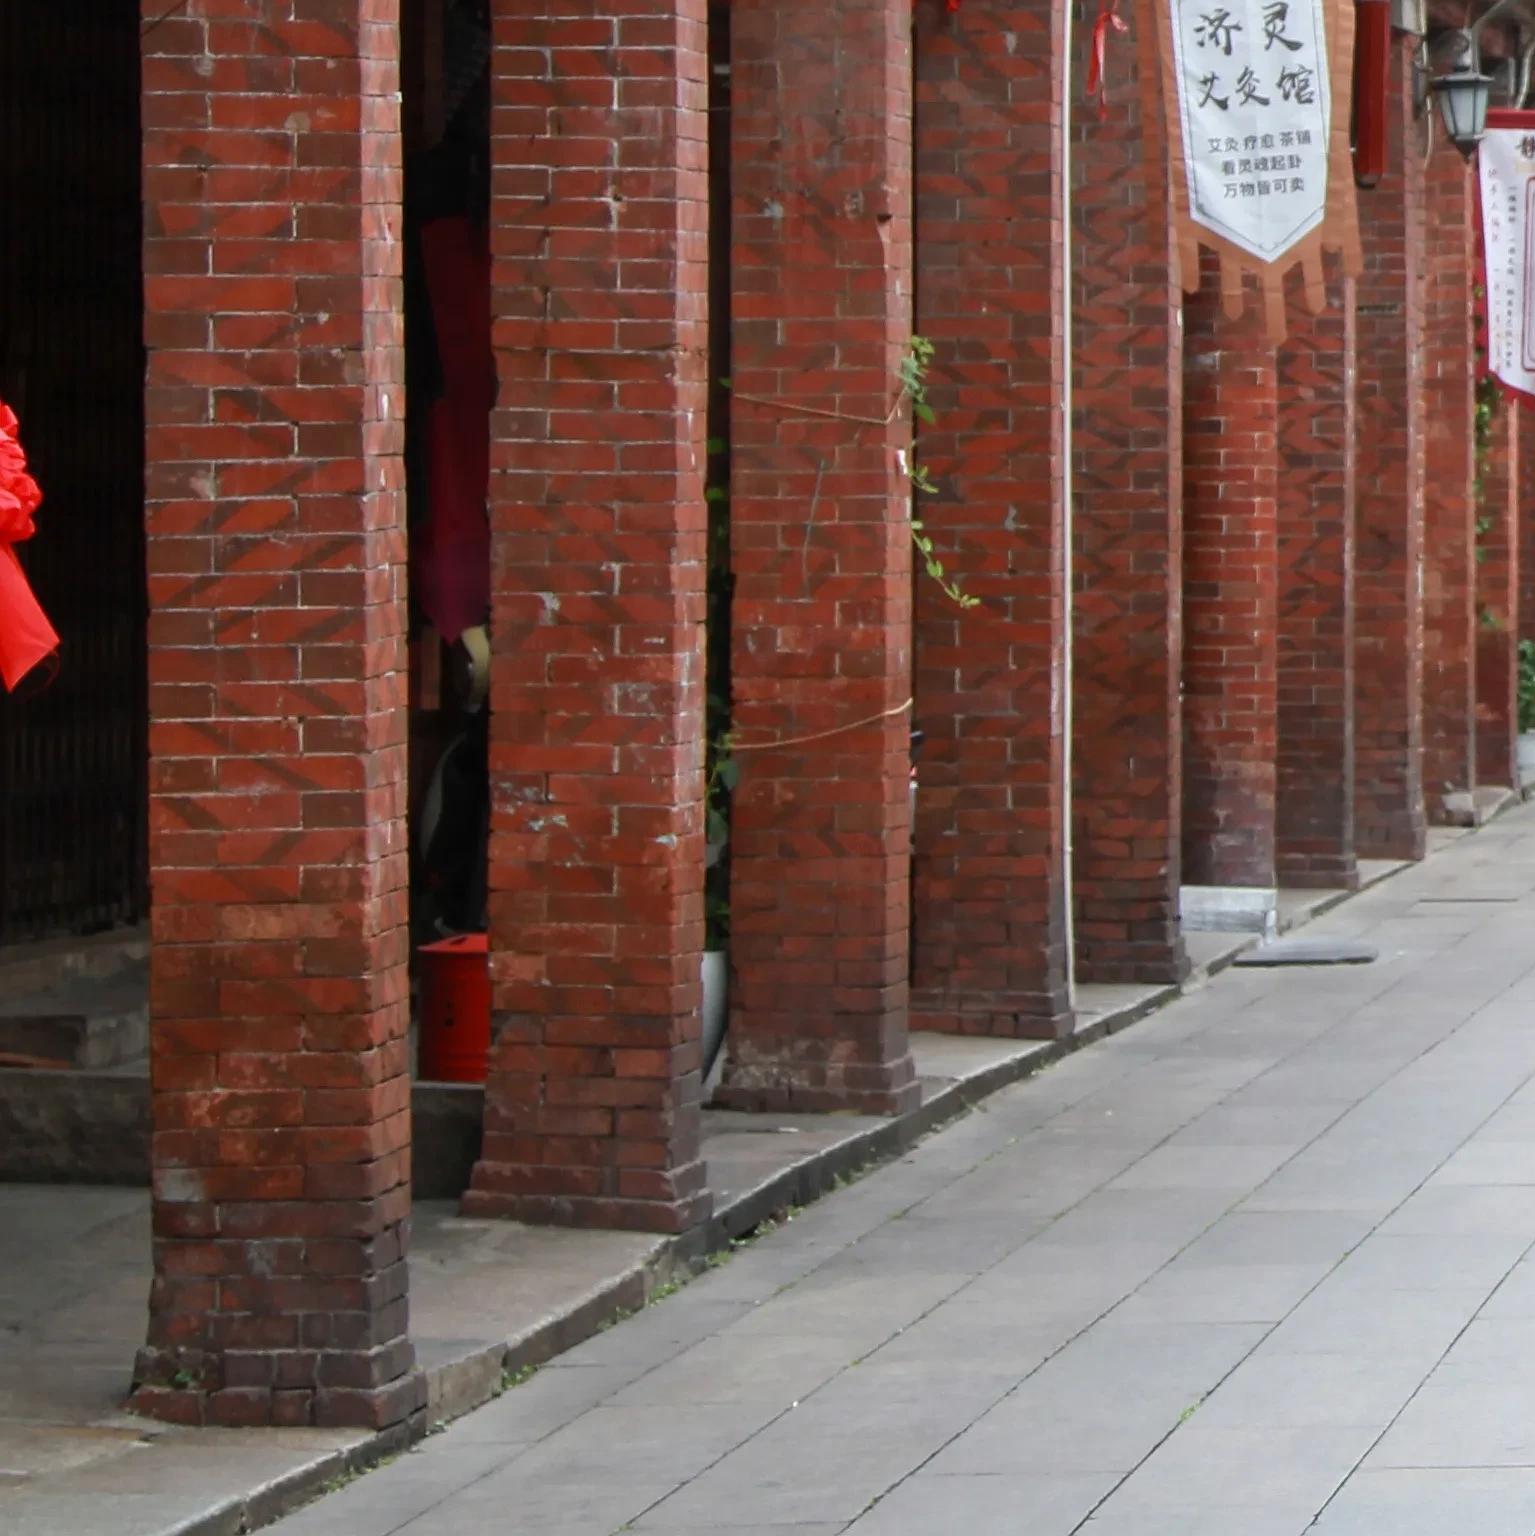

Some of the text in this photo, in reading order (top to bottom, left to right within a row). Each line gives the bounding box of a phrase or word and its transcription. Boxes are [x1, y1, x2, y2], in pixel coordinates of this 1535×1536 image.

[1194, 1, 1304, 55] 济灵
[1198, 65, 1315, 111] 艾灸馆
